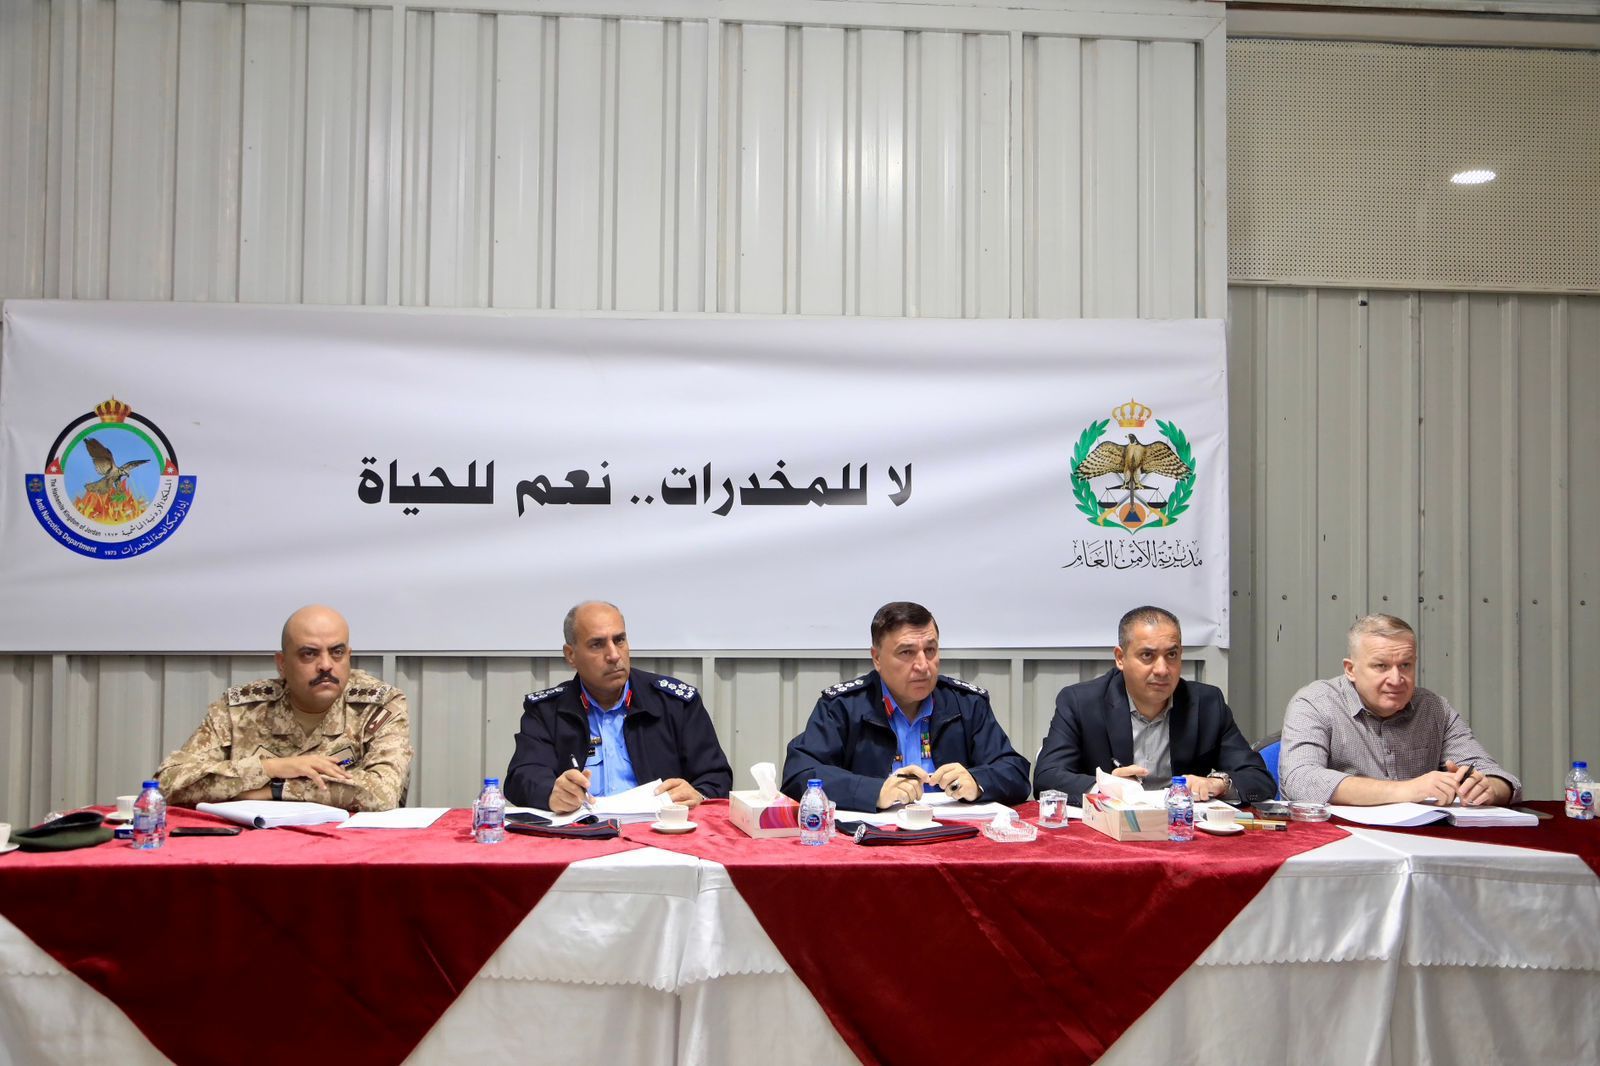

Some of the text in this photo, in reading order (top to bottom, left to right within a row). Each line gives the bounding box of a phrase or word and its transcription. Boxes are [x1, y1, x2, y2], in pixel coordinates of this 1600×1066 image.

[357, 456, 495, 516] للحياة
[515, 460, 612, 518] نعم
[888, 462, 912, 507] لا
[35, 498, 97, 554] Anti Narcotics Department
[51, 487, 65, 511] Hashemite
[62, 509, 80, 527] Kingdom
[85, 526, 101, 537] Jordan
[153, 514, 178, 540] مكافحة
[121, 535, 156, 555] المخدرات
